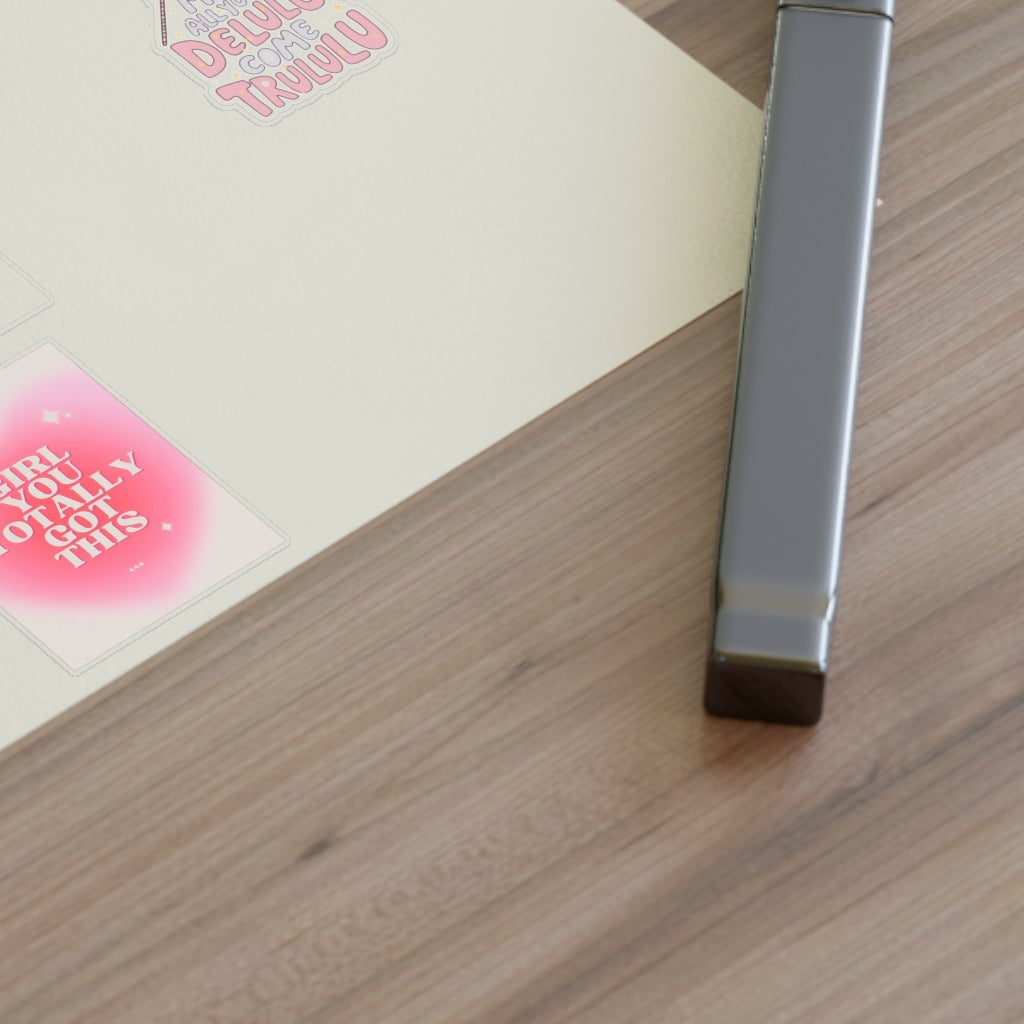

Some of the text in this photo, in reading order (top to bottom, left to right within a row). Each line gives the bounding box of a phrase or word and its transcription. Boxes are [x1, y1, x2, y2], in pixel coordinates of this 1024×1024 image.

[185, 8, 228, 37] ALL
[239, 18, 320, 74] COME
[215, 9, 388, 117] TRULULU
[0, 460, 82, 513] YOU
[44, 495, 119, 547] GOT
[54, 510, 149, 569] THIS
